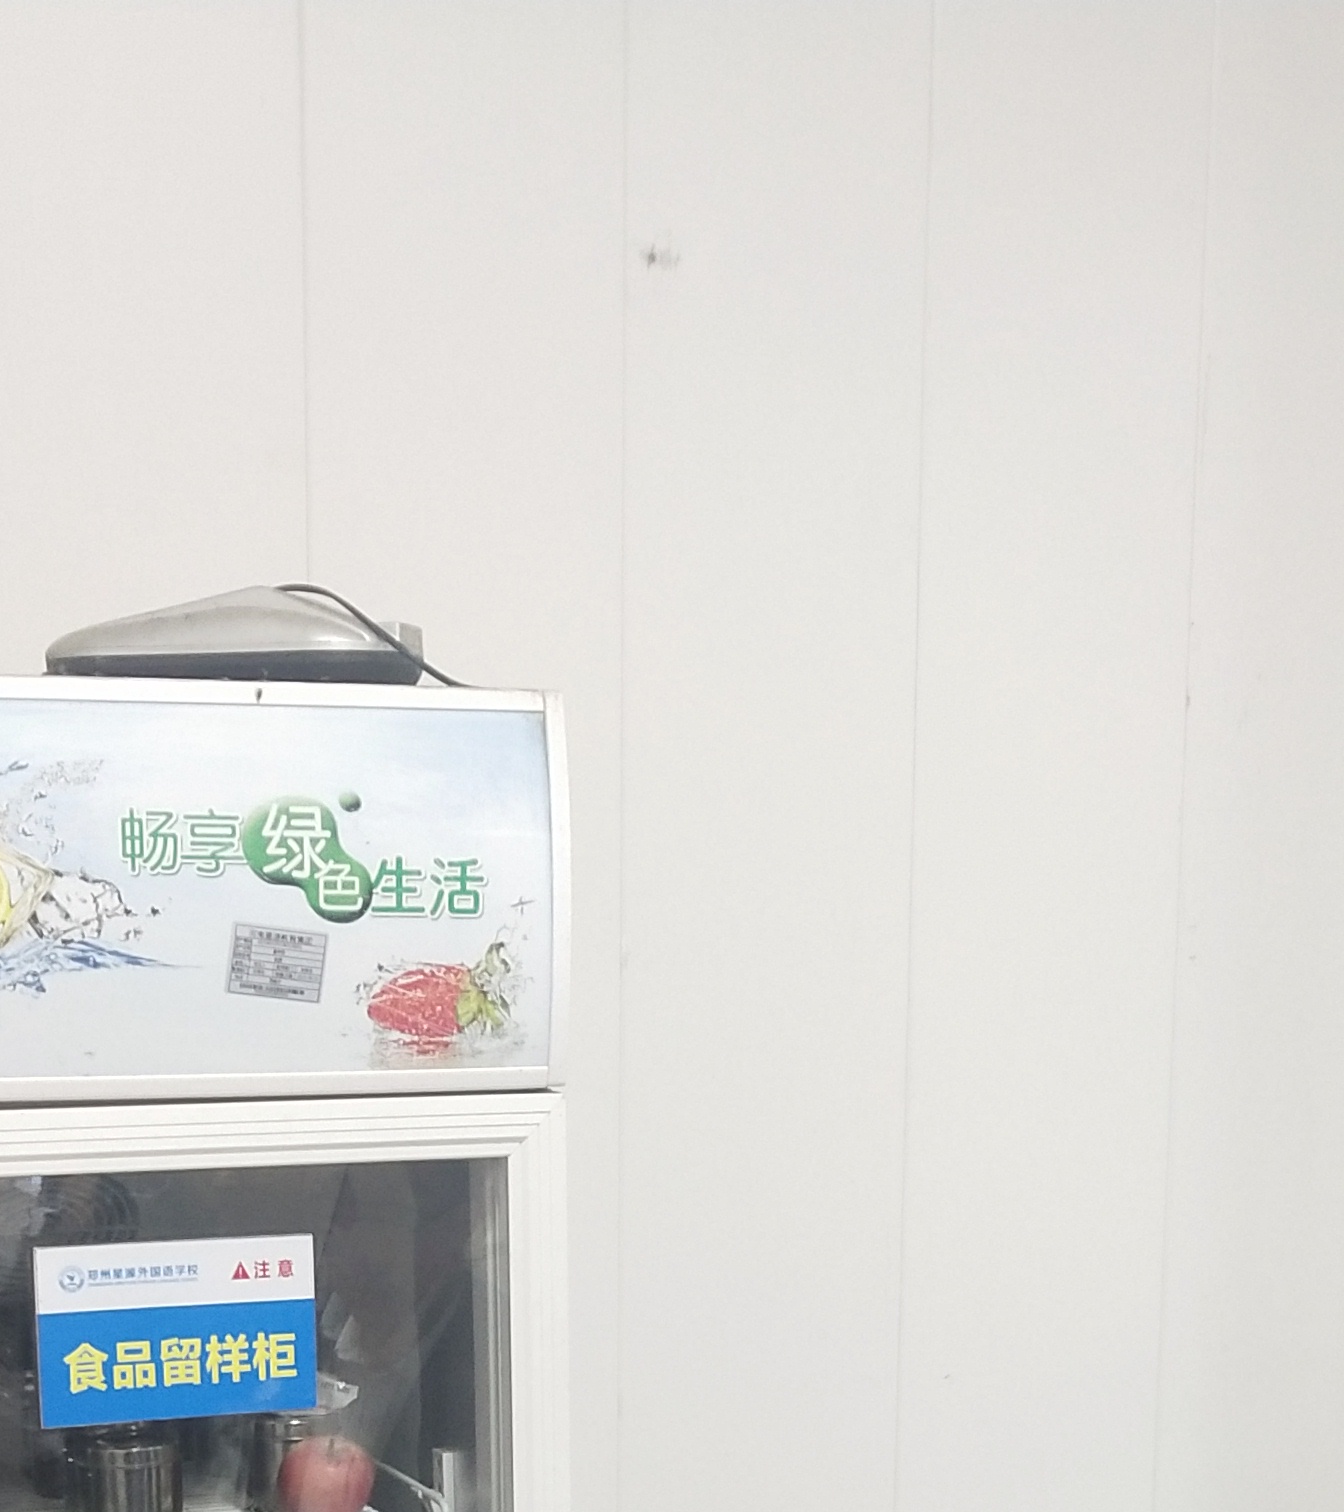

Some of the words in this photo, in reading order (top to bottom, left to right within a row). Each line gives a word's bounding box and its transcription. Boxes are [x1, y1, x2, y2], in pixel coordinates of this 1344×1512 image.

[120, 803, 485, 918] 畅享绿色生活
[254, 1259, 293, 1278] 注意
[63, 1332, 298, 1394] 食品留样柜
